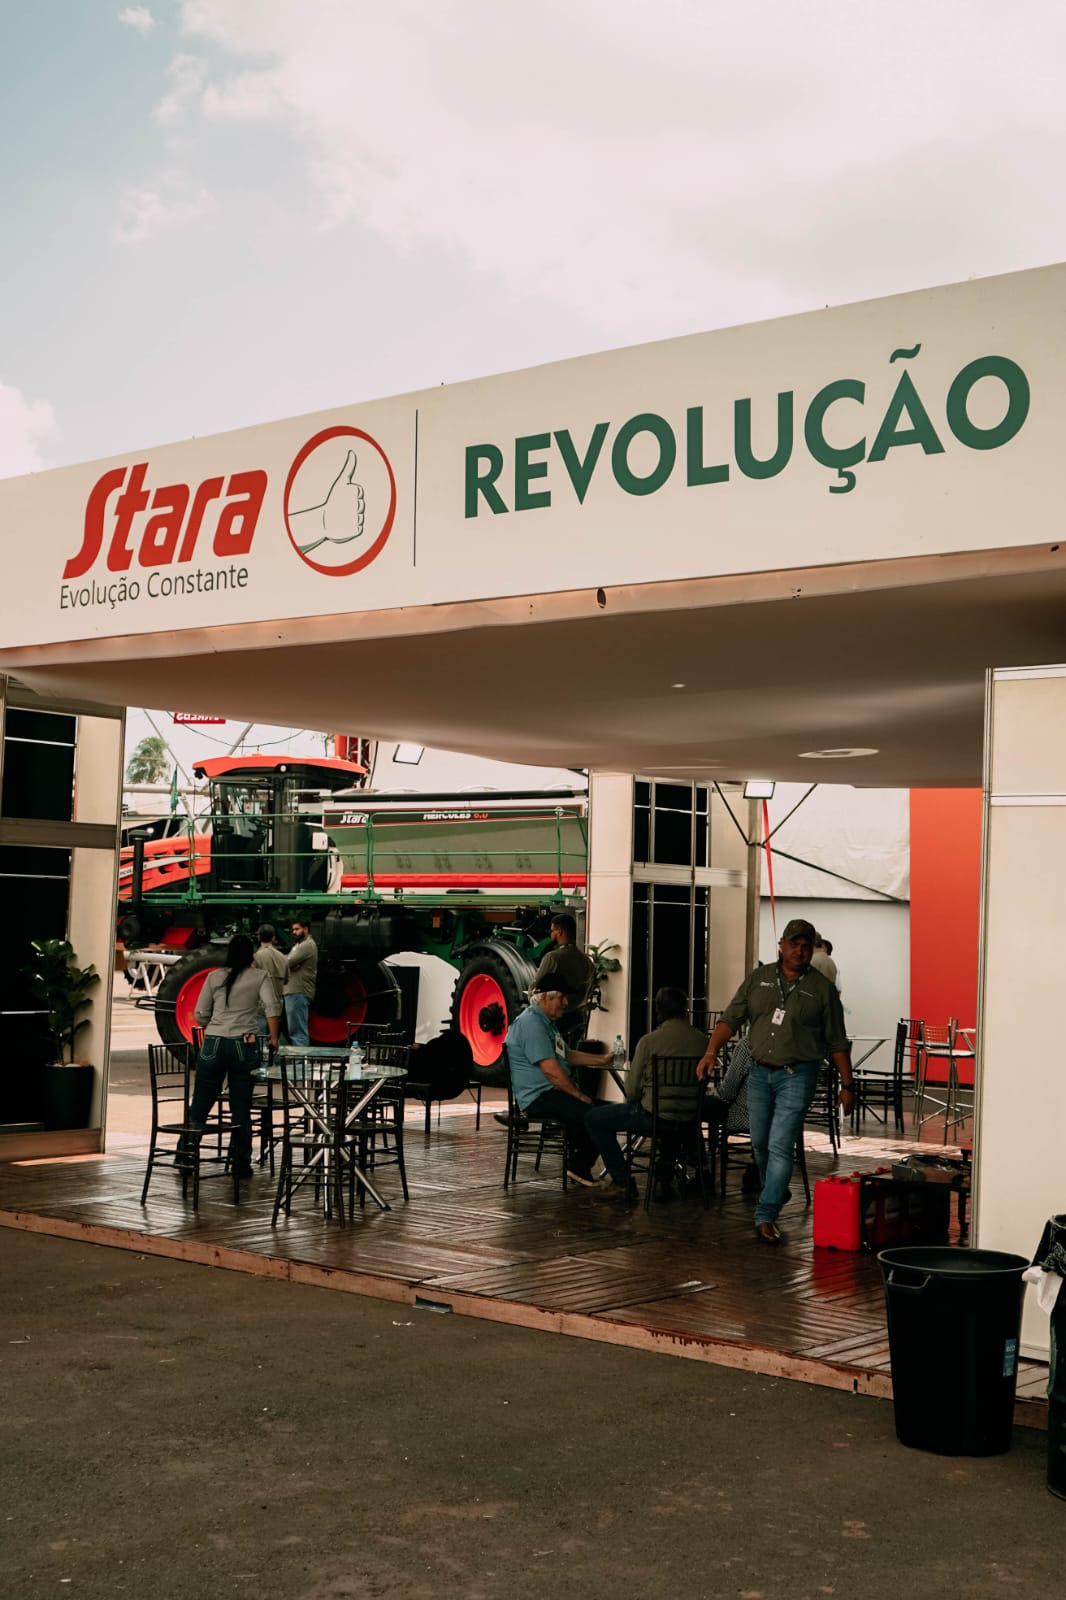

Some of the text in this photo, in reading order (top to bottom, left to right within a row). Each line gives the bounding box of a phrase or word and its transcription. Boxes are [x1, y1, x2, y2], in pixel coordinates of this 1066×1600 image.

[464, 343, 1030, 518] REVOLUÇÃO
[62, 462, 269, 580] Stara
[60, 564, 249, 610] Evolução Constante
